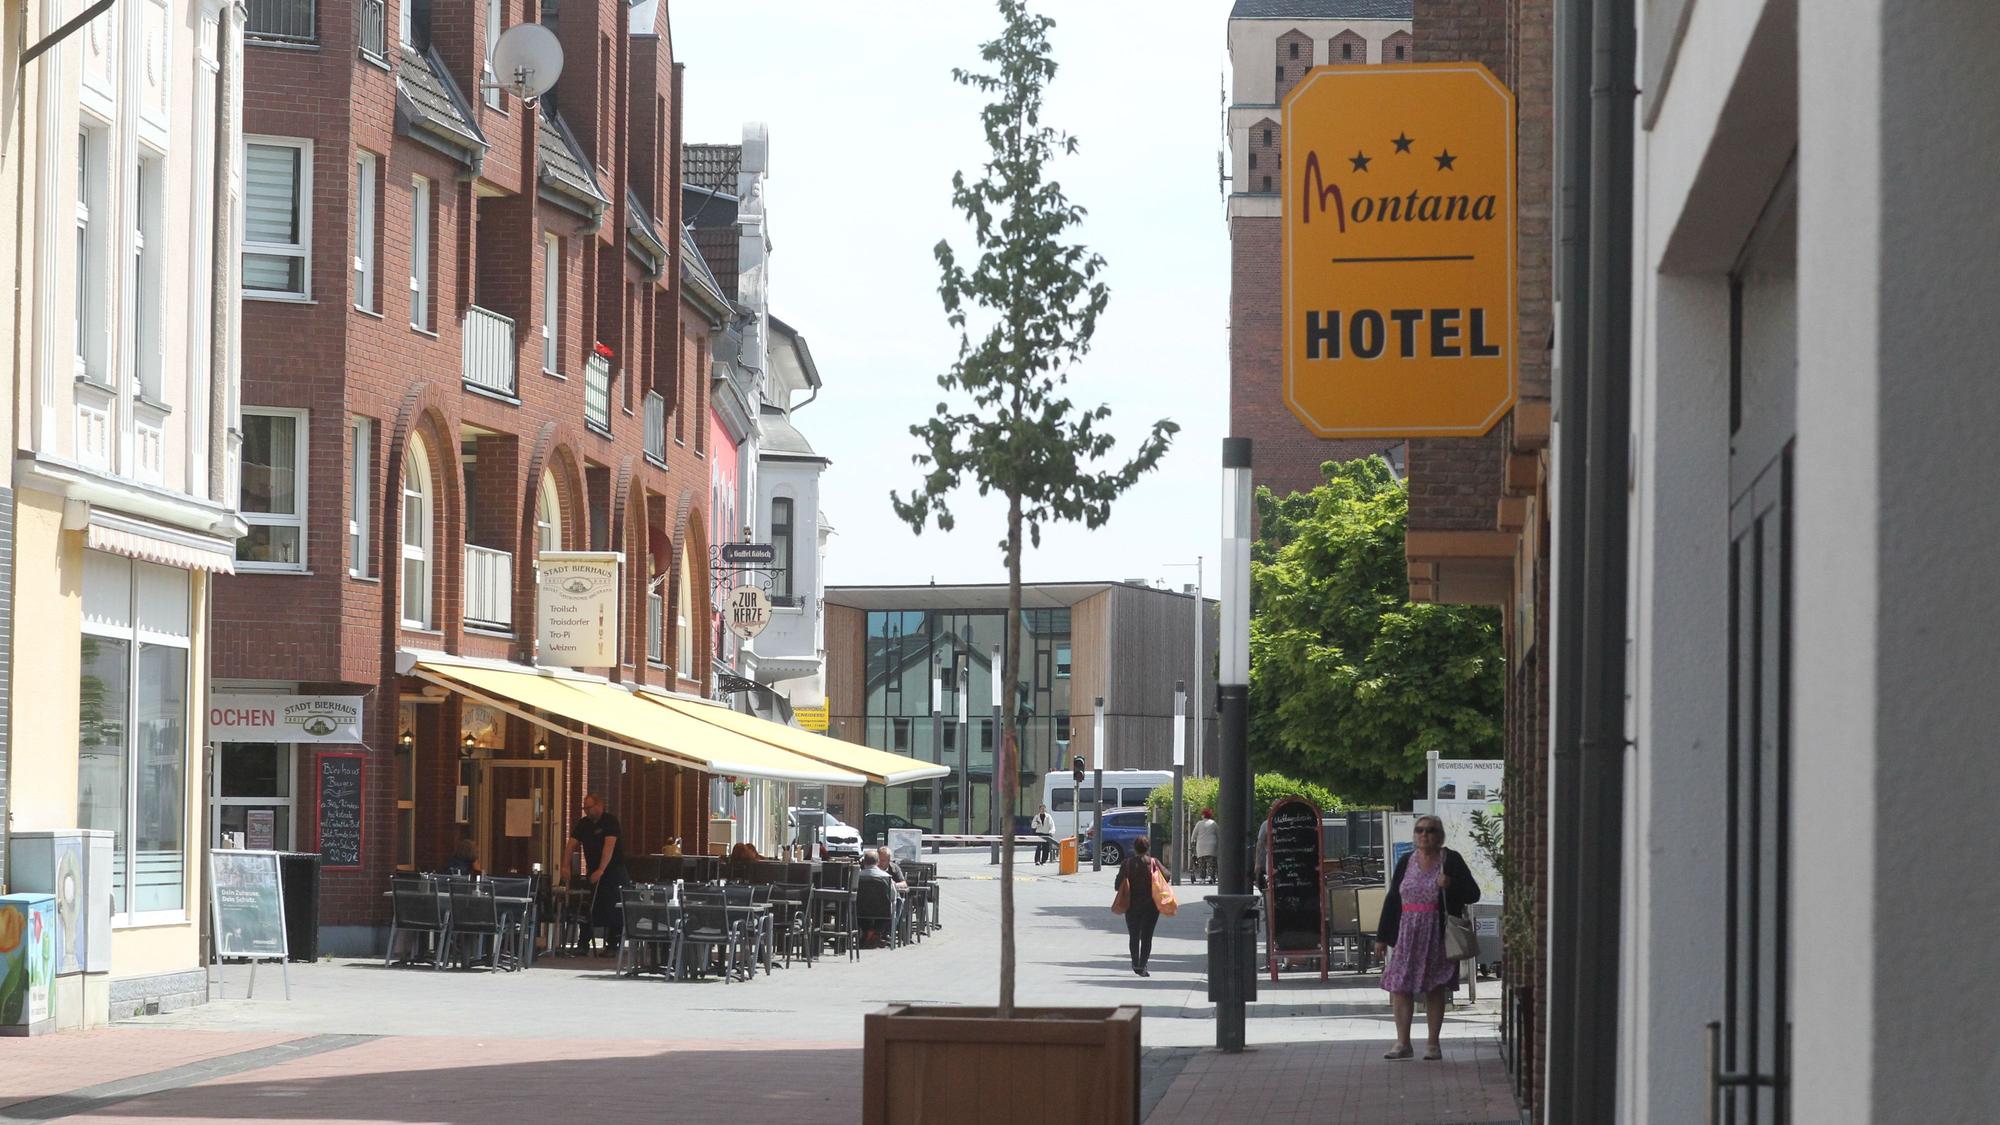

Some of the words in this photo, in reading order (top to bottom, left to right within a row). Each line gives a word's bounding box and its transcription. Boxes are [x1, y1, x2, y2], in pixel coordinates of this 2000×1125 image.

[1302, 149, 1496, 234] Montana
[1305, 306, 1502, 361] HOTEL
[543, 565, 569, 577] STADT
[572, 565, 612, 578] BIERHAUS
[739, 592, 757, 607] ZUR
[550, 605, 577, 613] Troilsch
[734, 607, 762, 623] KERZE
[549, 631, 570, 639] Tro-Pi
[549, 643, 577, 651] Weizen
[284, 702, 312, 715] STADT
[314, 701, 357, 715] BIERHAUS
[1437, 762, 1473, 770] WEGWEISUNG
